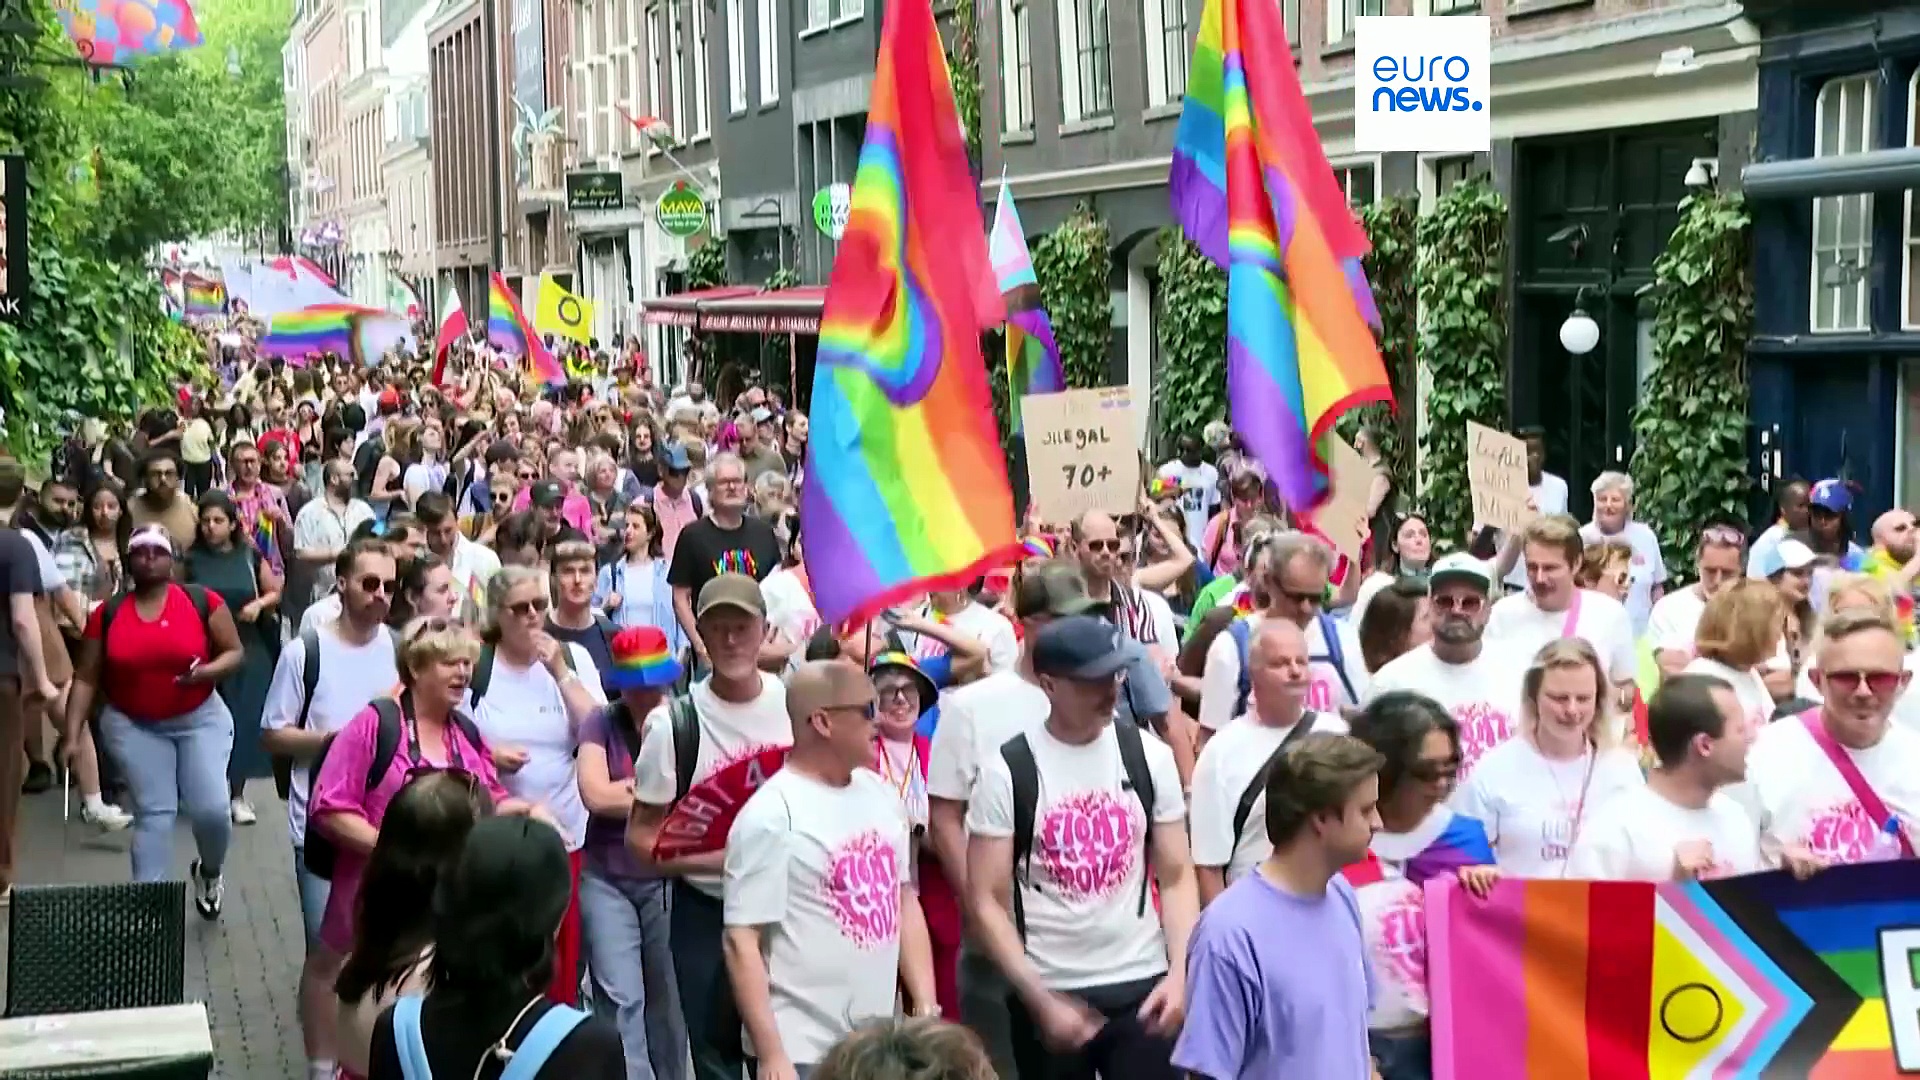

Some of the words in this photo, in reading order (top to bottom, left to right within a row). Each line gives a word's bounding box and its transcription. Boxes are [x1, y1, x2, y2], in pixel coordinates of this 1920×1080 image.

[661, 200, 703, 214] MAYA
[821, 204, 850, 214] PIZZ
[1062, 463, 1112, 490] 70+
[1043, 806, 1130, 850] FIGHT
